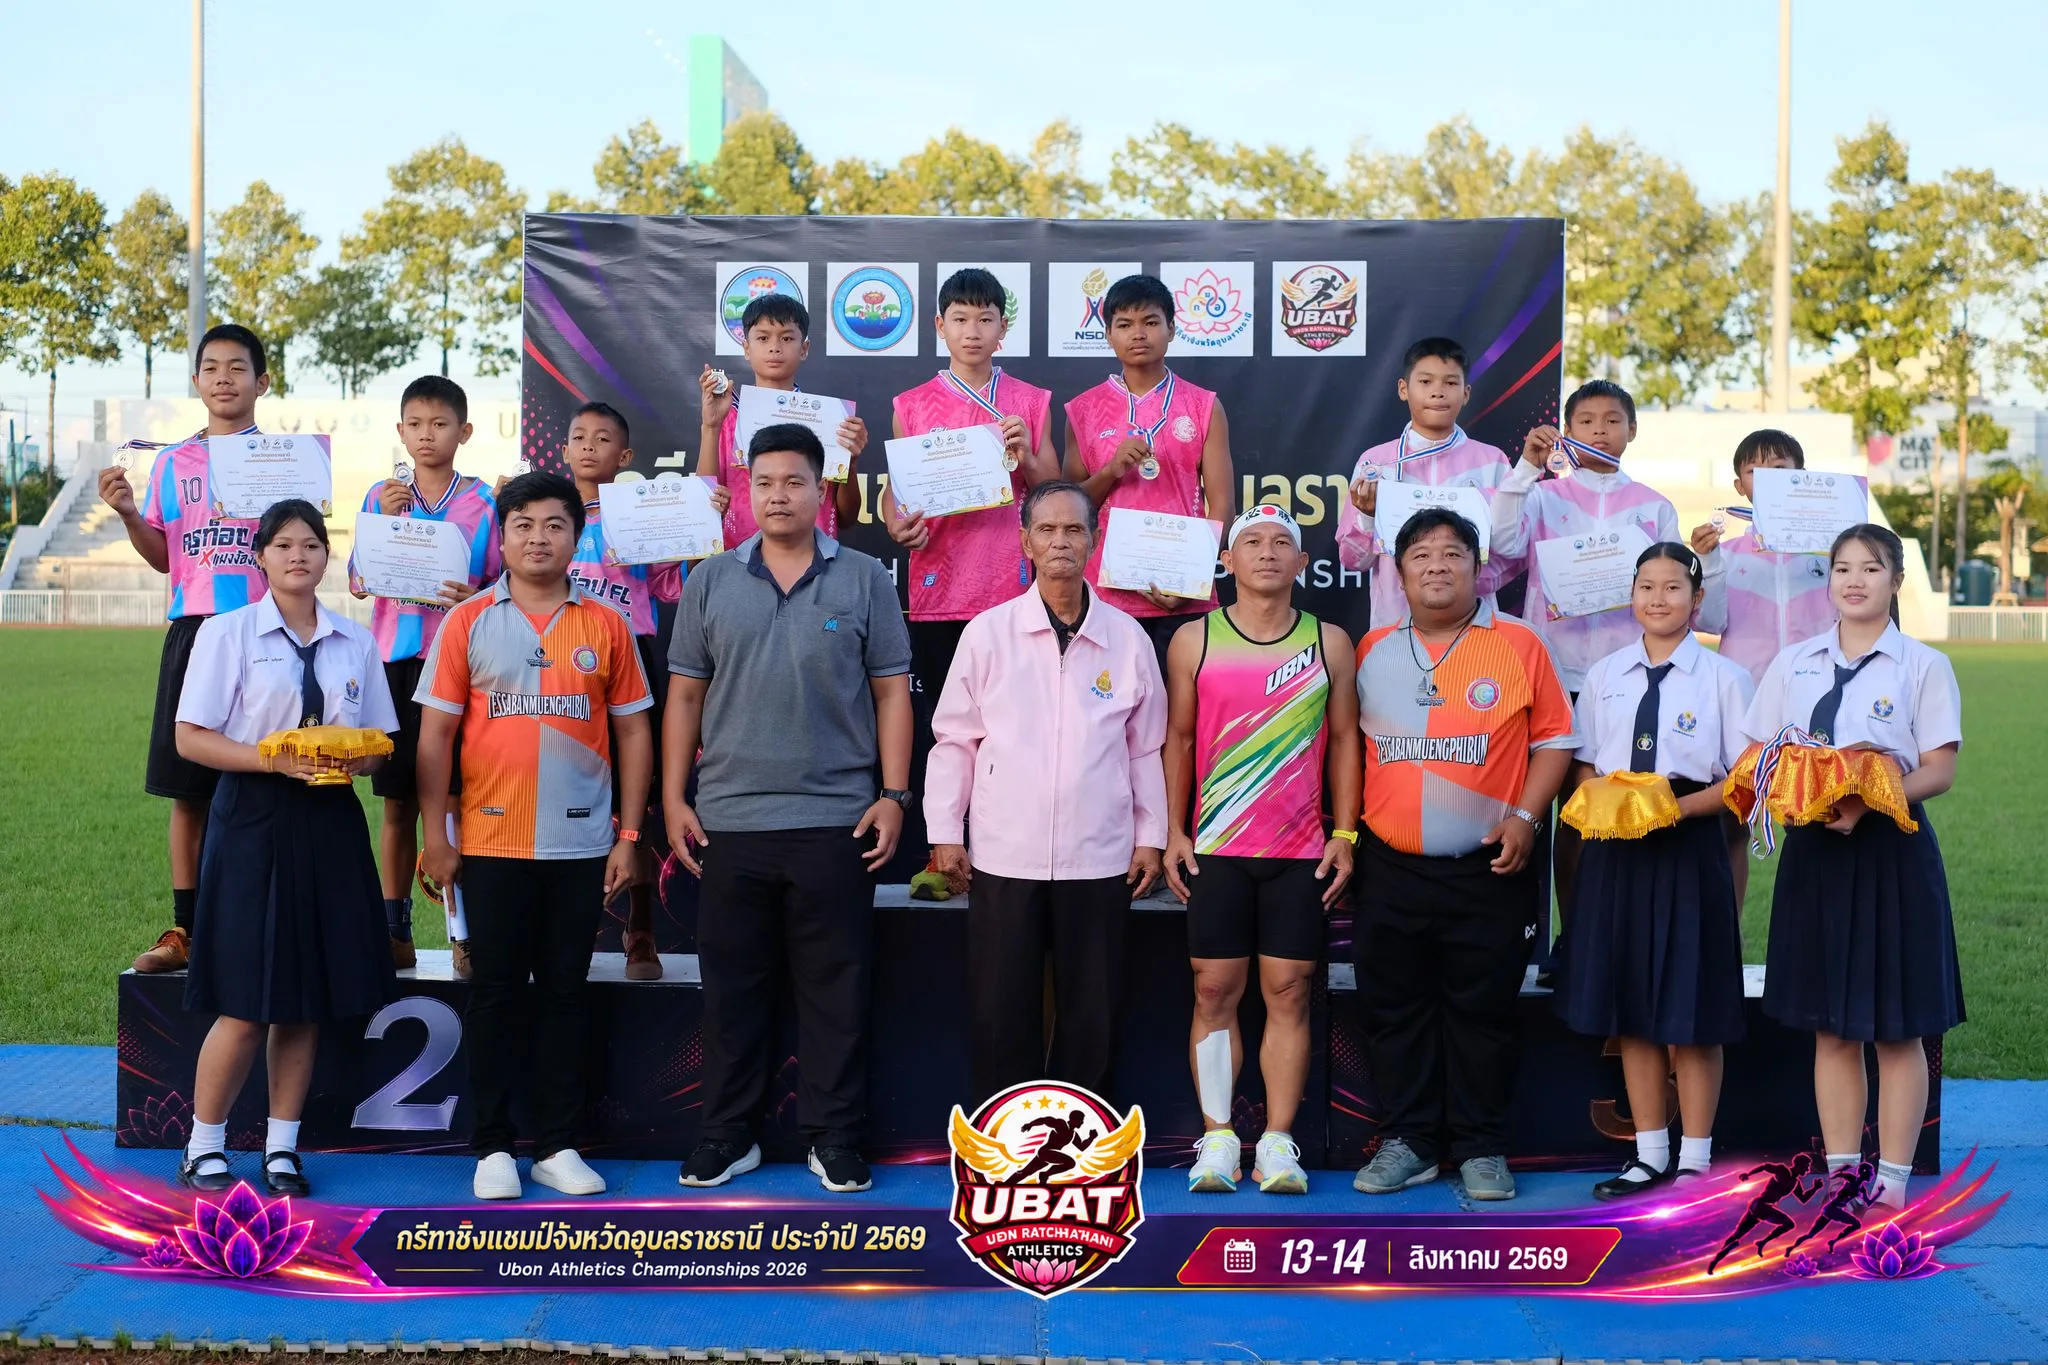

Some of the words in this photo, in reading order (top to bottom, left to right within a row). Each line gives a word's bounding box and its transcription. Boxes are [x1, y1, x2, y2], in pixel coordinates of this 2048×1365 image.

[1174, 311, 1253, 347] กีฬาจังหวัดอุบลราชธานี
[1286, 310, 1352, 327] UBAT
[1075, 331, 1107, 340] NSD
[1100, 429, 1117, 439] CPU
[1899, 437, 1937, 451] MA
[1899, 456, 1931, 471] CIT
[180, 476, 203, 505] 10
[1265, 642, 1316, 696] UBN
[1374, 732, 1490, 767] TESSABANMUENGPHIBUN
[351, 996, 463, 1131] 2
